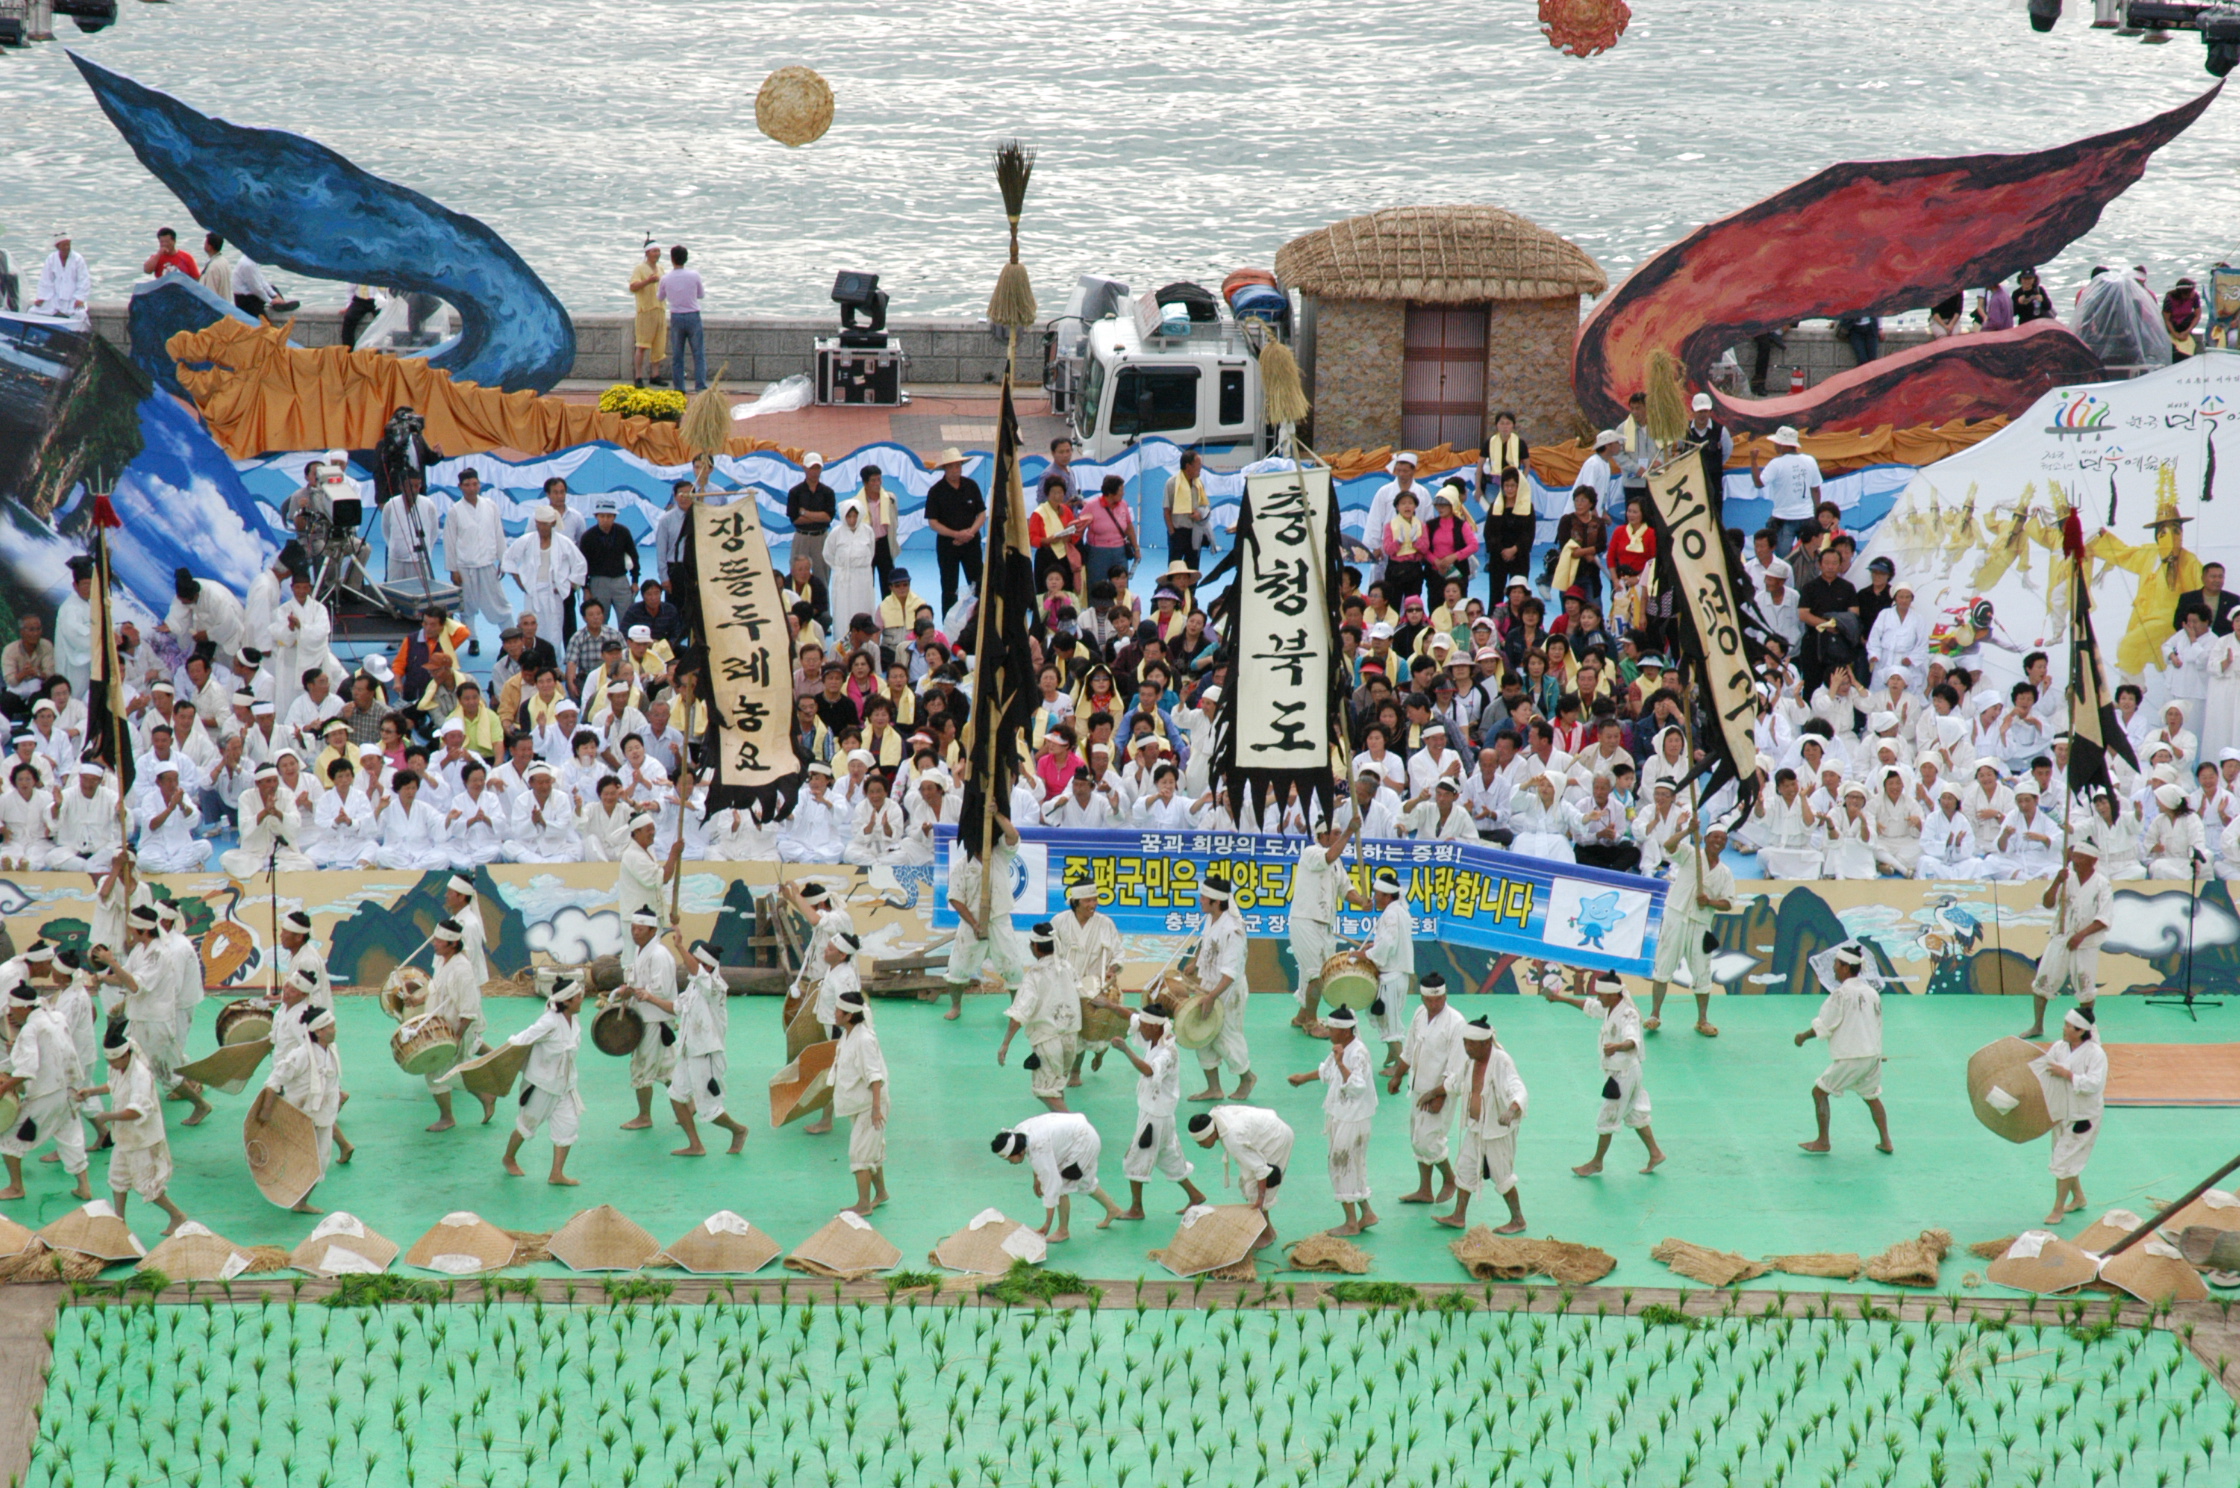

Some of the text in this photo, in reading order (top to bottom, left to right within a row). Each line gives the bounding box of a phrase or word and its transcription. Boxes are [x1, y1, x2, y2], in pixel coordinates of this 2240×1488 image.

[709, 511, 772, 772] 장뜰두레농요
[1249, 485, 1318, 752] 충청북도
[1140, 833, 1184, 854] 꿈과
[1192, 834, 1256, 857] 희망의
[1411, 844, 1463, 864] 증평!
[1062, 855, 1199, 907] 증평군민은
[1406, 865, 1535, 929] 사랑합니다
[1165, 912, 1201, 932] 충북
